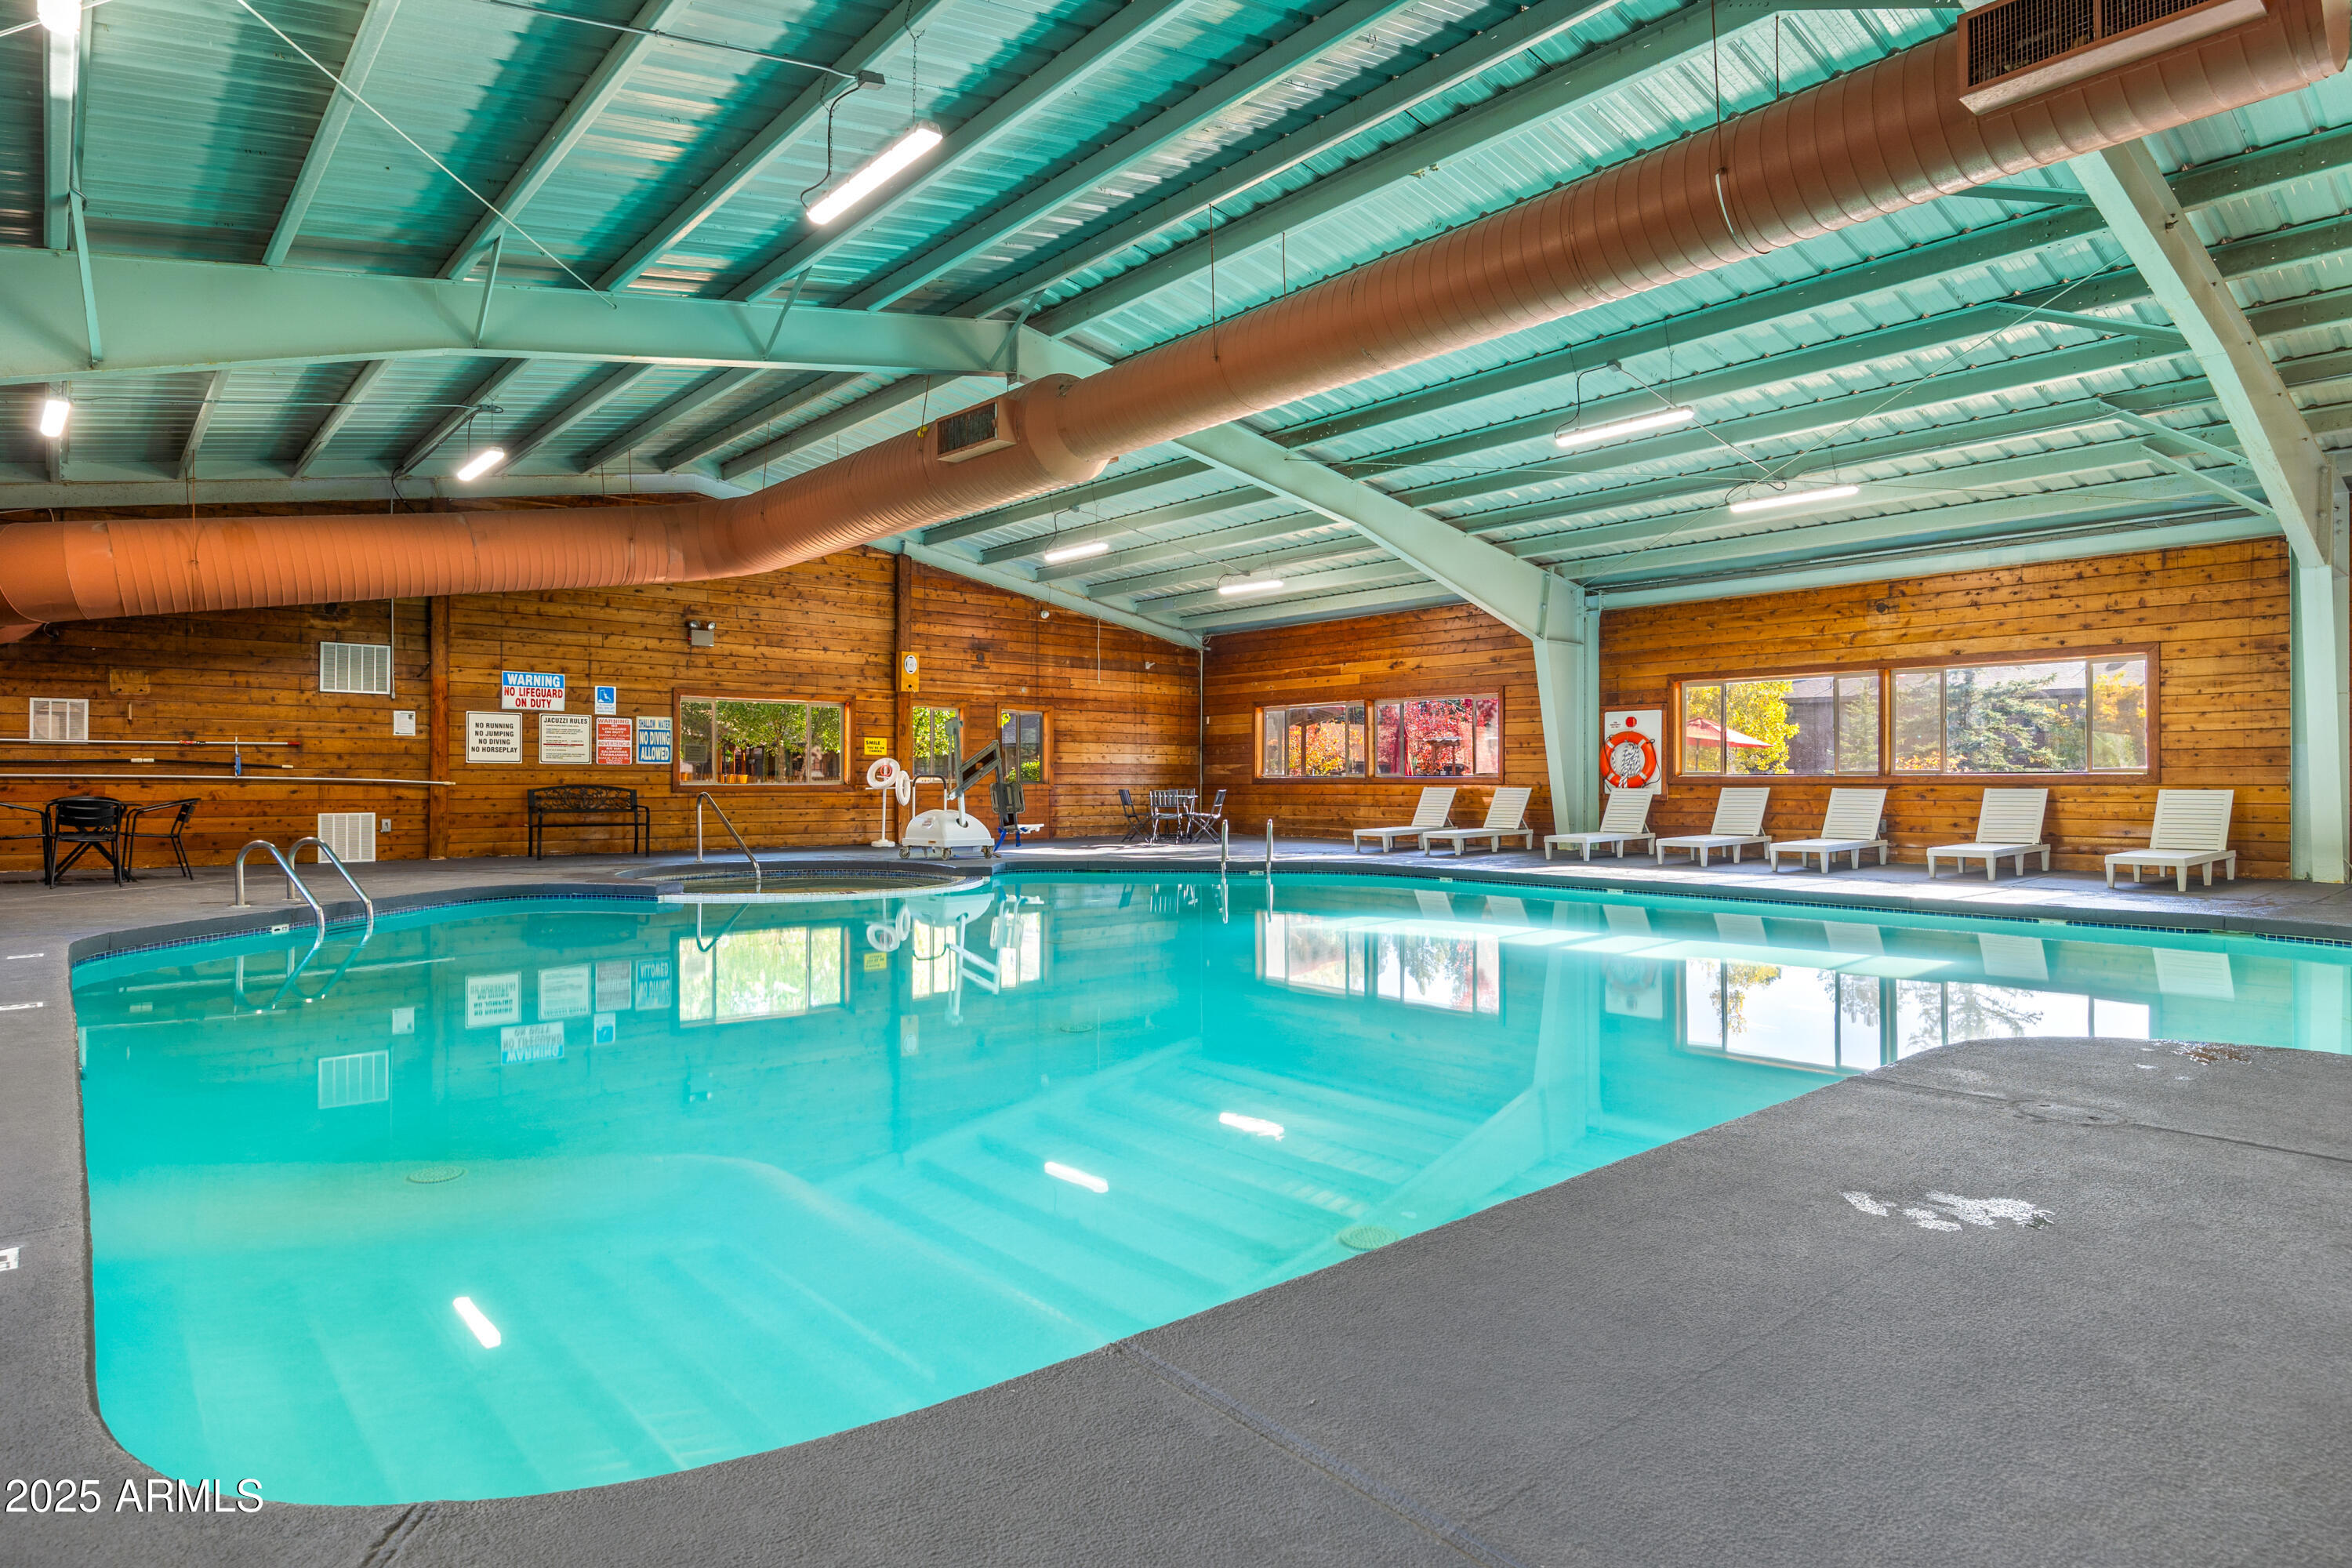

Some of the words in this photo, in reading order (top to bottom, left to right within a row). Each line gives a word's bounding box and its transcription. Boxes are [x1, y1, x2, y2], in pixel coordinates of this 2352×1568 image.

[507, 673, 560, 687] WARNING
[504, 687, 515, 696] NO
[519, 687, 563, 698] LIFEGUARD
[515, 698, 527, 707] ON
[530, 699, 551, 708] DUTY
[639, 719, 656, 728] SHALLOW
[658, 720, 671, 729] WATER
[640, 731, 648, 745] NO
[650, 731, 670, 746] DIVING
[641, 747, 669, 760] ALLOWED
